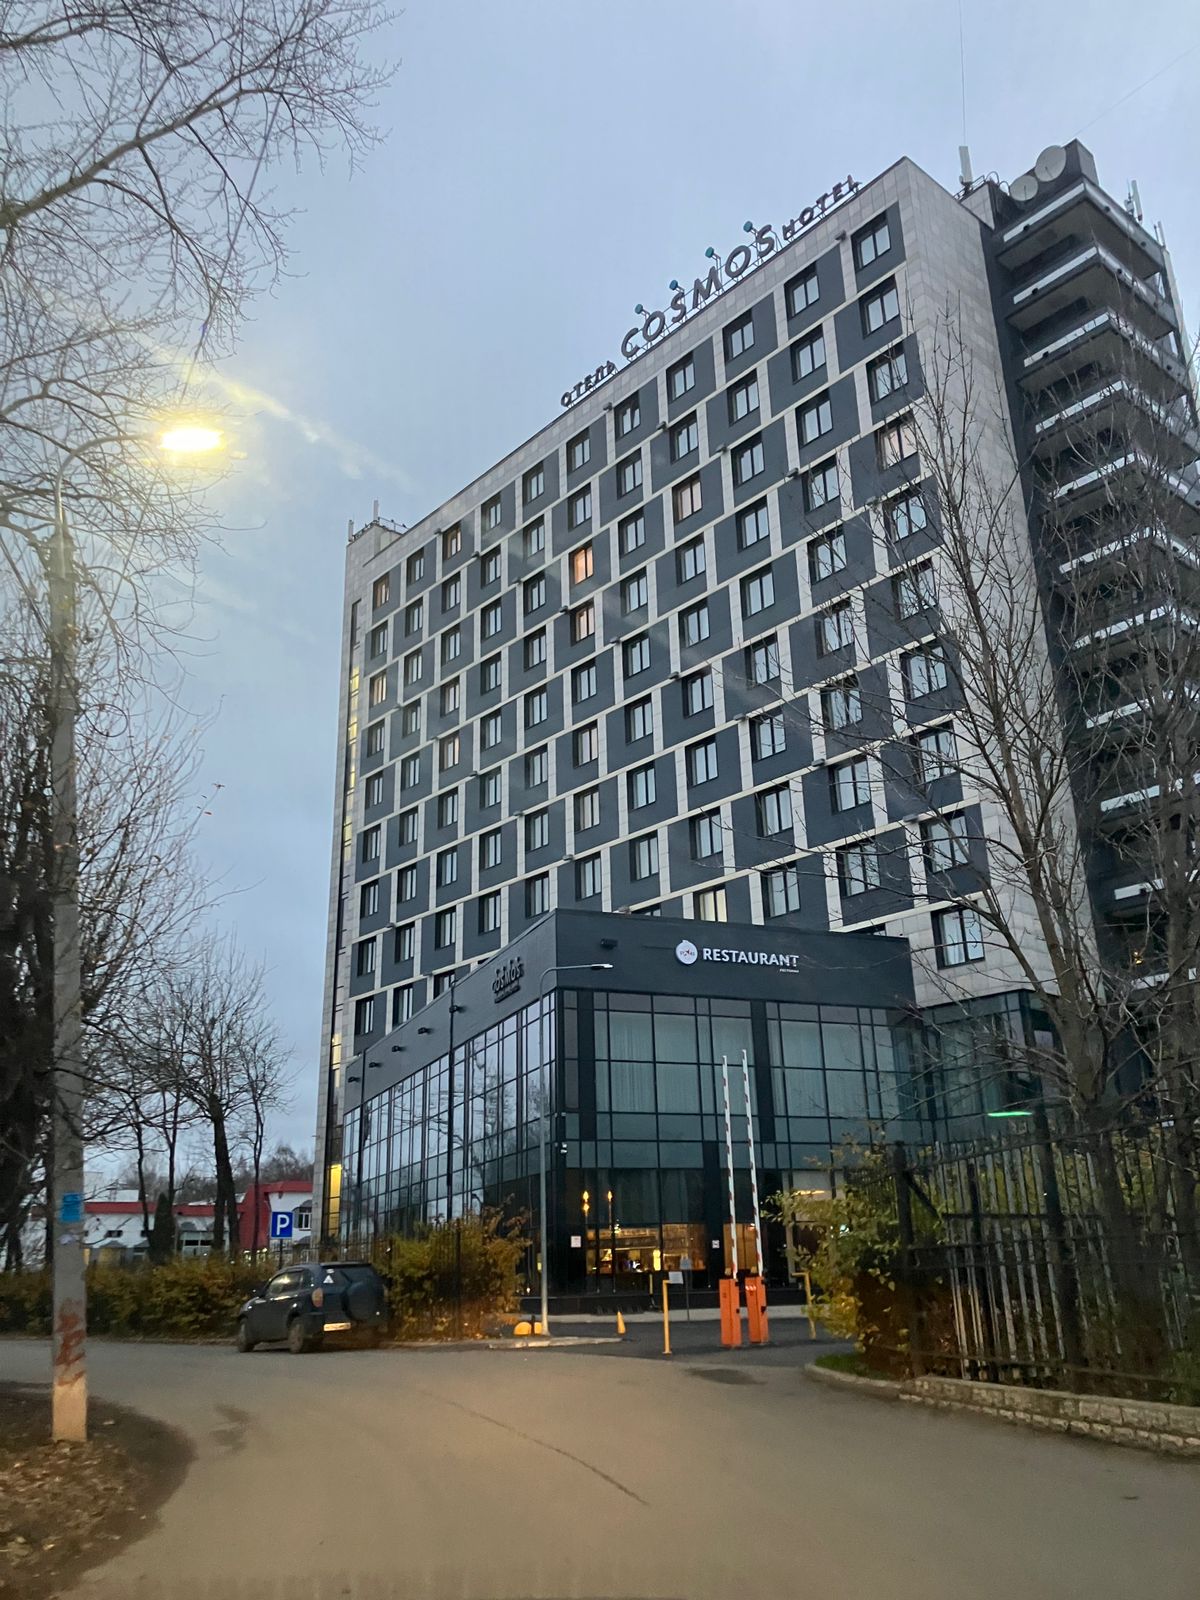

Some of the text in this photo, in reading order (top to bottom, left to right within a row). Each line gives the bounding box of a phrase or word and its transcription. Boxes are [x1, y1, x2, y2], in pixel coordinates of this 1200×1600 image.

[560, 174, 862, 407] ОТЕЛЬ COSMOS HOTEL
[702, 947, 800, 967] RESTAURANT
[276, 1213, 290, 1236] P
